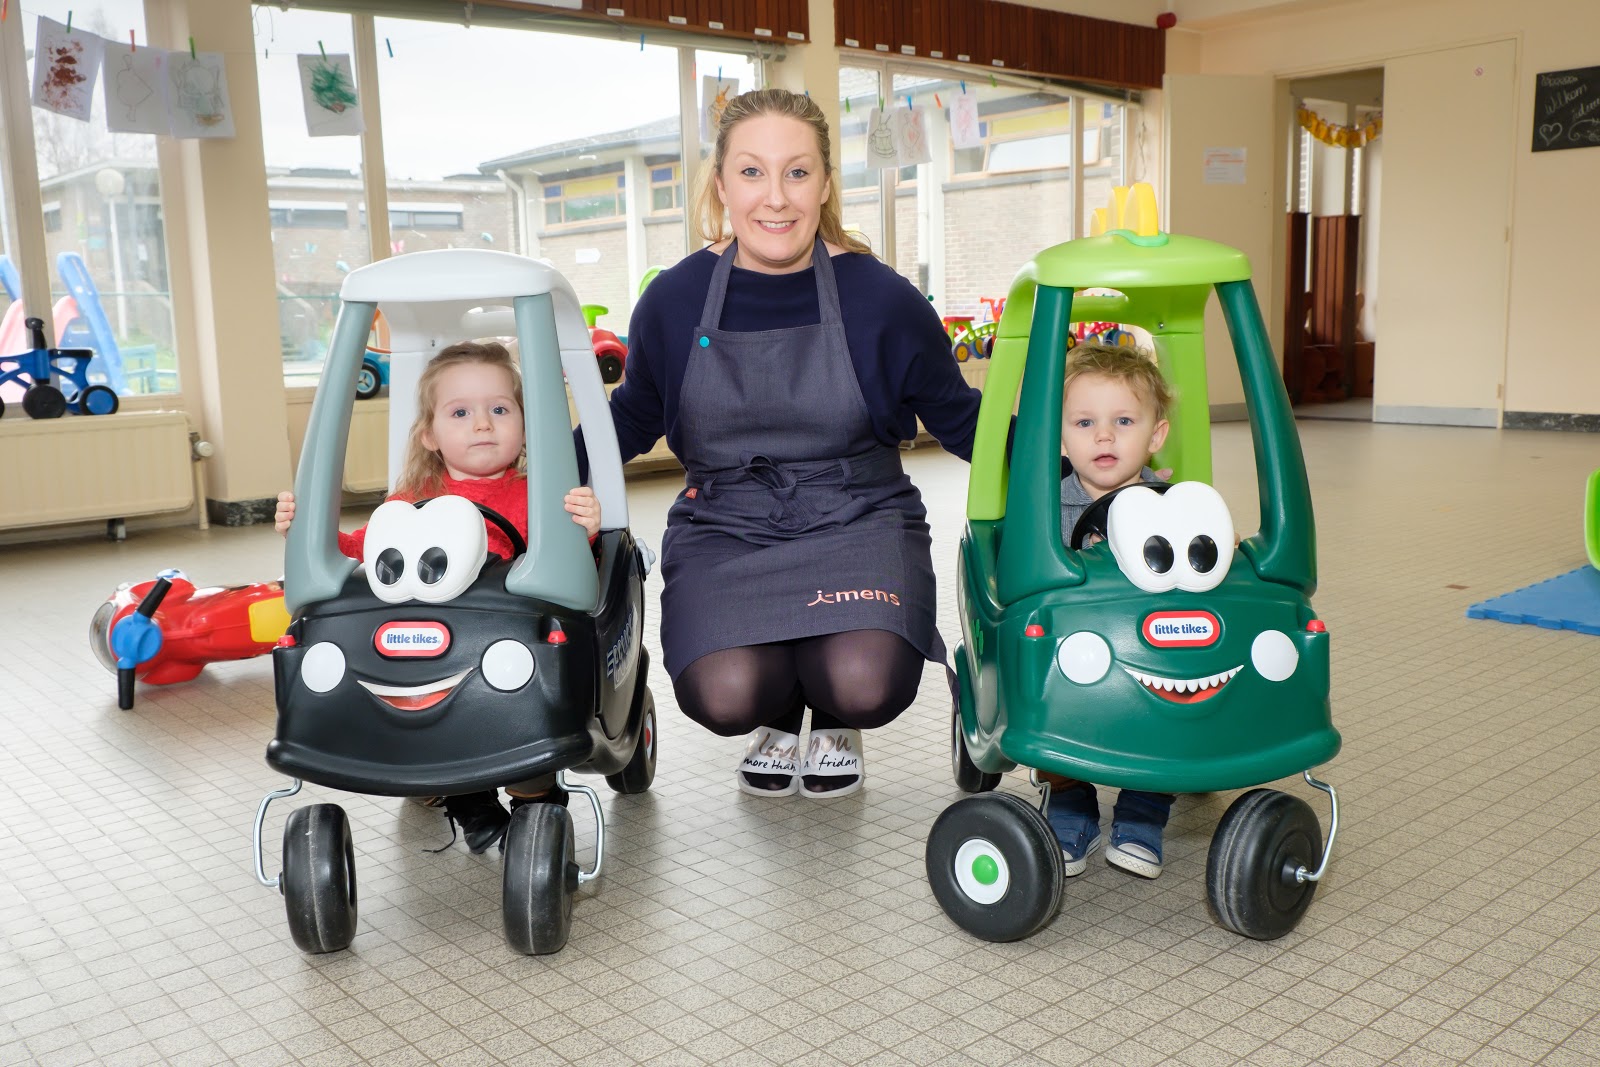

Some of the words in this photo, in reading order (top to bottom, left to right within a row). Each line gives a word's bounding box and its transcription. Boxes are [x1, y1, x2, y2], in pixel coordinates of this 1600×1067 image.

[807, 589, 900, 607] i-mens
[1154, 624, 1181, 635] little
[1181, 623, 1208, 634] tikes
[386, 633, 411, 644] little
[412, 633, 438, 644] tikes
[808, 734, 852, 765] you
[743, 757, 768, 769] more
[771, 760, 797, 773] than
[818, 754, 858, 770] friday
